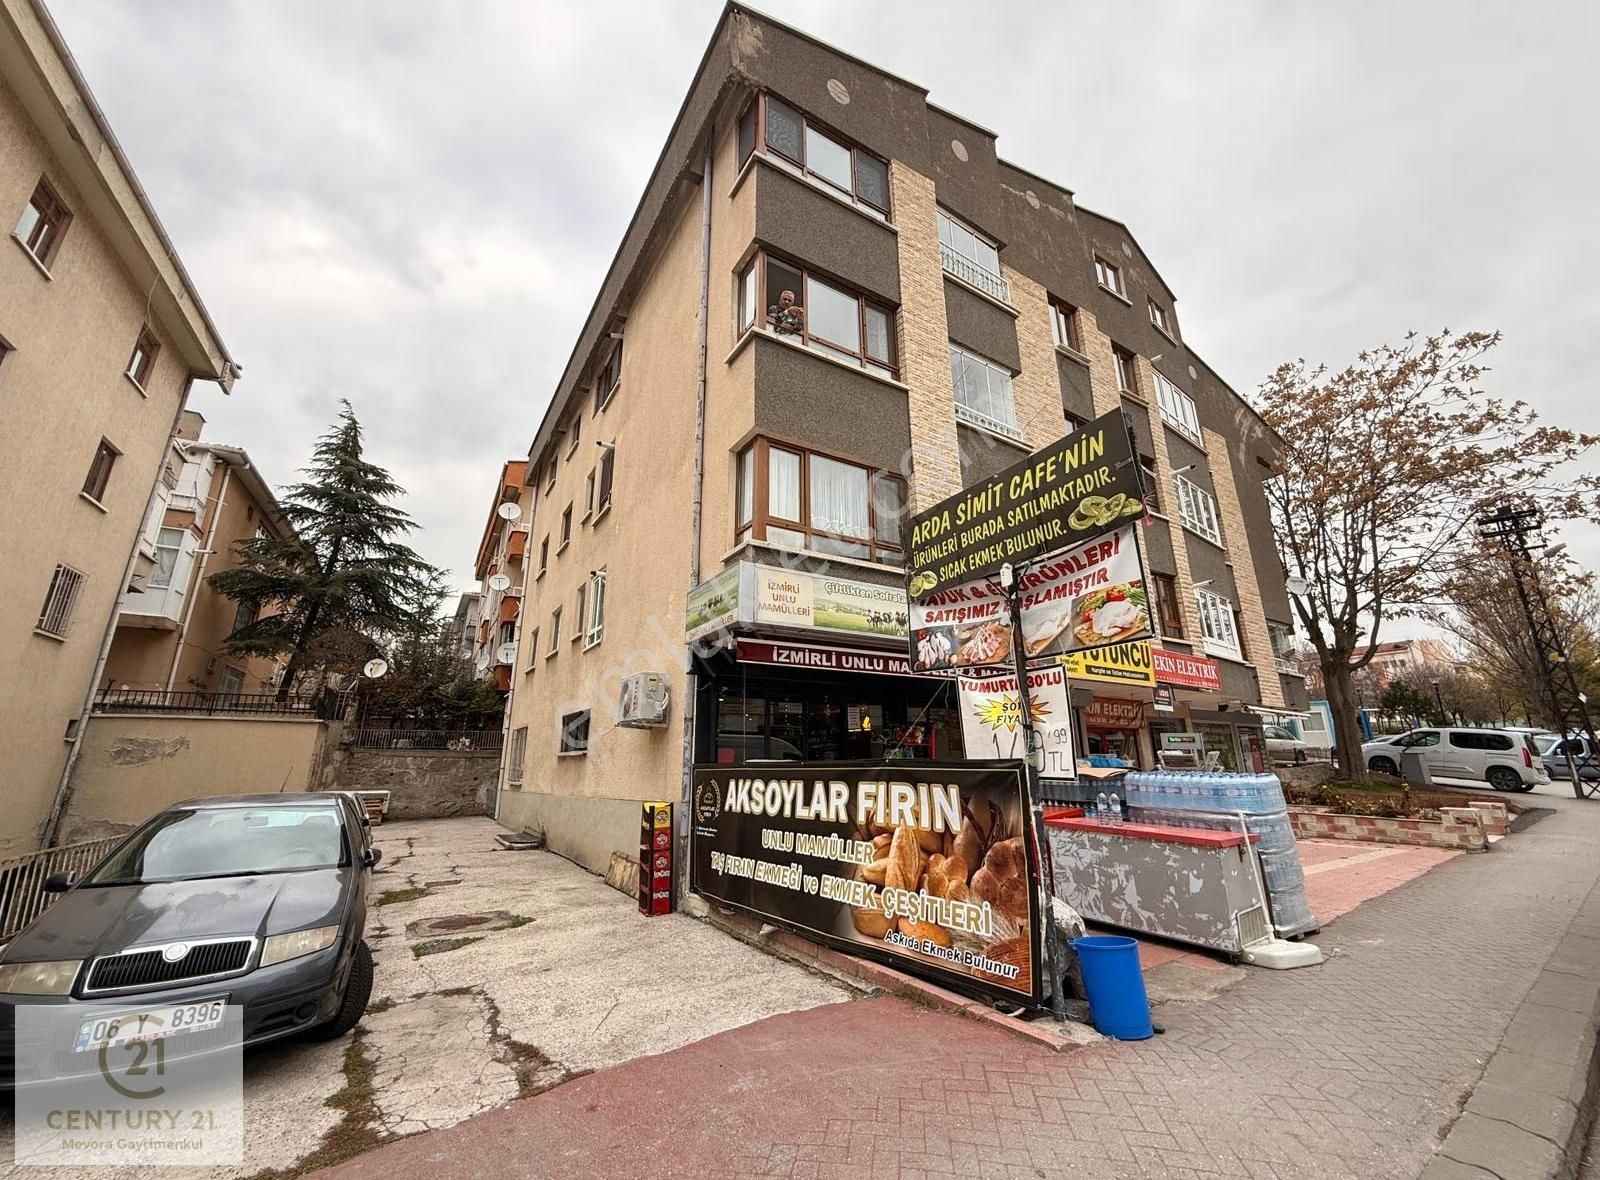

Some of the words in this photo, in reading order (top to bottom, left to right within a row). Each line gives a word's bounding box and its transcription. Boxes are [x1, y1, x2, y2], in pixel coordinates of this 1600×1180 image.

[911, 513, 950, 548] ARDA
[956, 482, 1004, 525] SİMİT
[1009, 430, 1104, 500] CAFE'NİN
[913, 538, 959, 569] ÜRÜNLERİ
[961, 519, 1005, 549] BURADA
[1007, 466, 1116, 528] SATILMAKTADIR.
[939, 561, 967, 582] SICAK
[970, 541, 1004, 570] EKMEK
[1005, 519, 1067, 556] BULUNUR.
[767, 578, 800, 595] İZMİRLİ
[772, 593, 796, 604] UNLU
[824, 581, 873, 599] Çiftlikten
[873, 590, 907, 604] Sofrala
[757, 602, 811, 617] MAMÜLLERİ
[925, 602, 999, 624] SATIŞIMIZ
[772, 646, 836, 667] İZMİRLİ
[842, 655, 884, 671] UNLU
[1153, 654, 1175, 673] EKİN
[1176, 659, 1218, 680] ELEKTRİK
[1027, 671, 1061, 689] 30'LU
[997, 715, 1021, 724] FİYA
[1048, 751, 1070, 773] TL
[724, 778, 850, 824] AKSOYLAR
[856, 780, 963, 835] FIRIN
[761, 828, 794, 852] UNLU
[795, 833, 875, 866] MAMÜLLER
[711, 851, 724, 876] TAŞ
[724, 856, 754, 879] FIRIN
[754, 862, 801, 891] EKMEĞİ
[803, 874, 819, 894] ve
[820, 873, 876, 909] EKMEK
[880, 886, 993, 937] ÇEŞİTLERİ
[885, 929, 921, 952] Askıda
[922, 940, 961, 963] Ekmek
[963, 951, 1020, 979] Bulunur
[94, 1019, 121, 1042] 06
[171, 1002, 222, 1028] 8396
